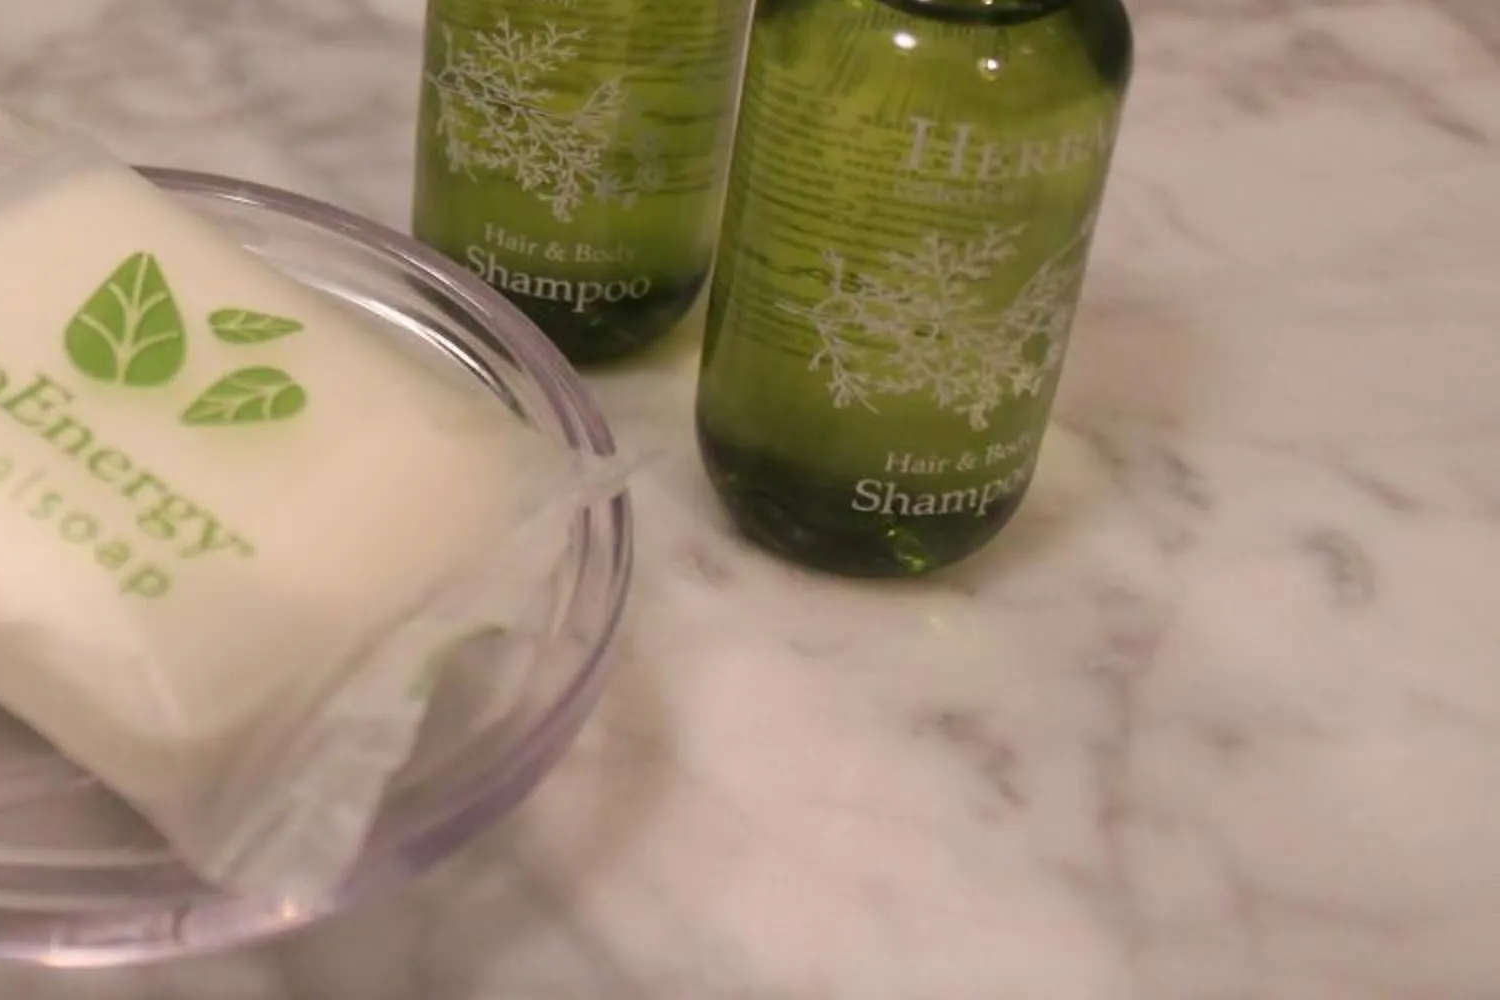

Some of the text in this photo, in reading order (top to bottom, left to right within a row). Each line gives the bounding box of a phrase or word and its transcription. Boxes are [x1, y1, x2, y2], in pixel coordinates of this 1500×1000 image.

[902, 115, 1108, 180] HERB
[482, 221, 540, 257] Hair
[543, 239, 569, 263] &
[465, 244, 653, 314] Shampoo
[883, 449, 952, 475] Hair
[955, 450, 978, 473] &
